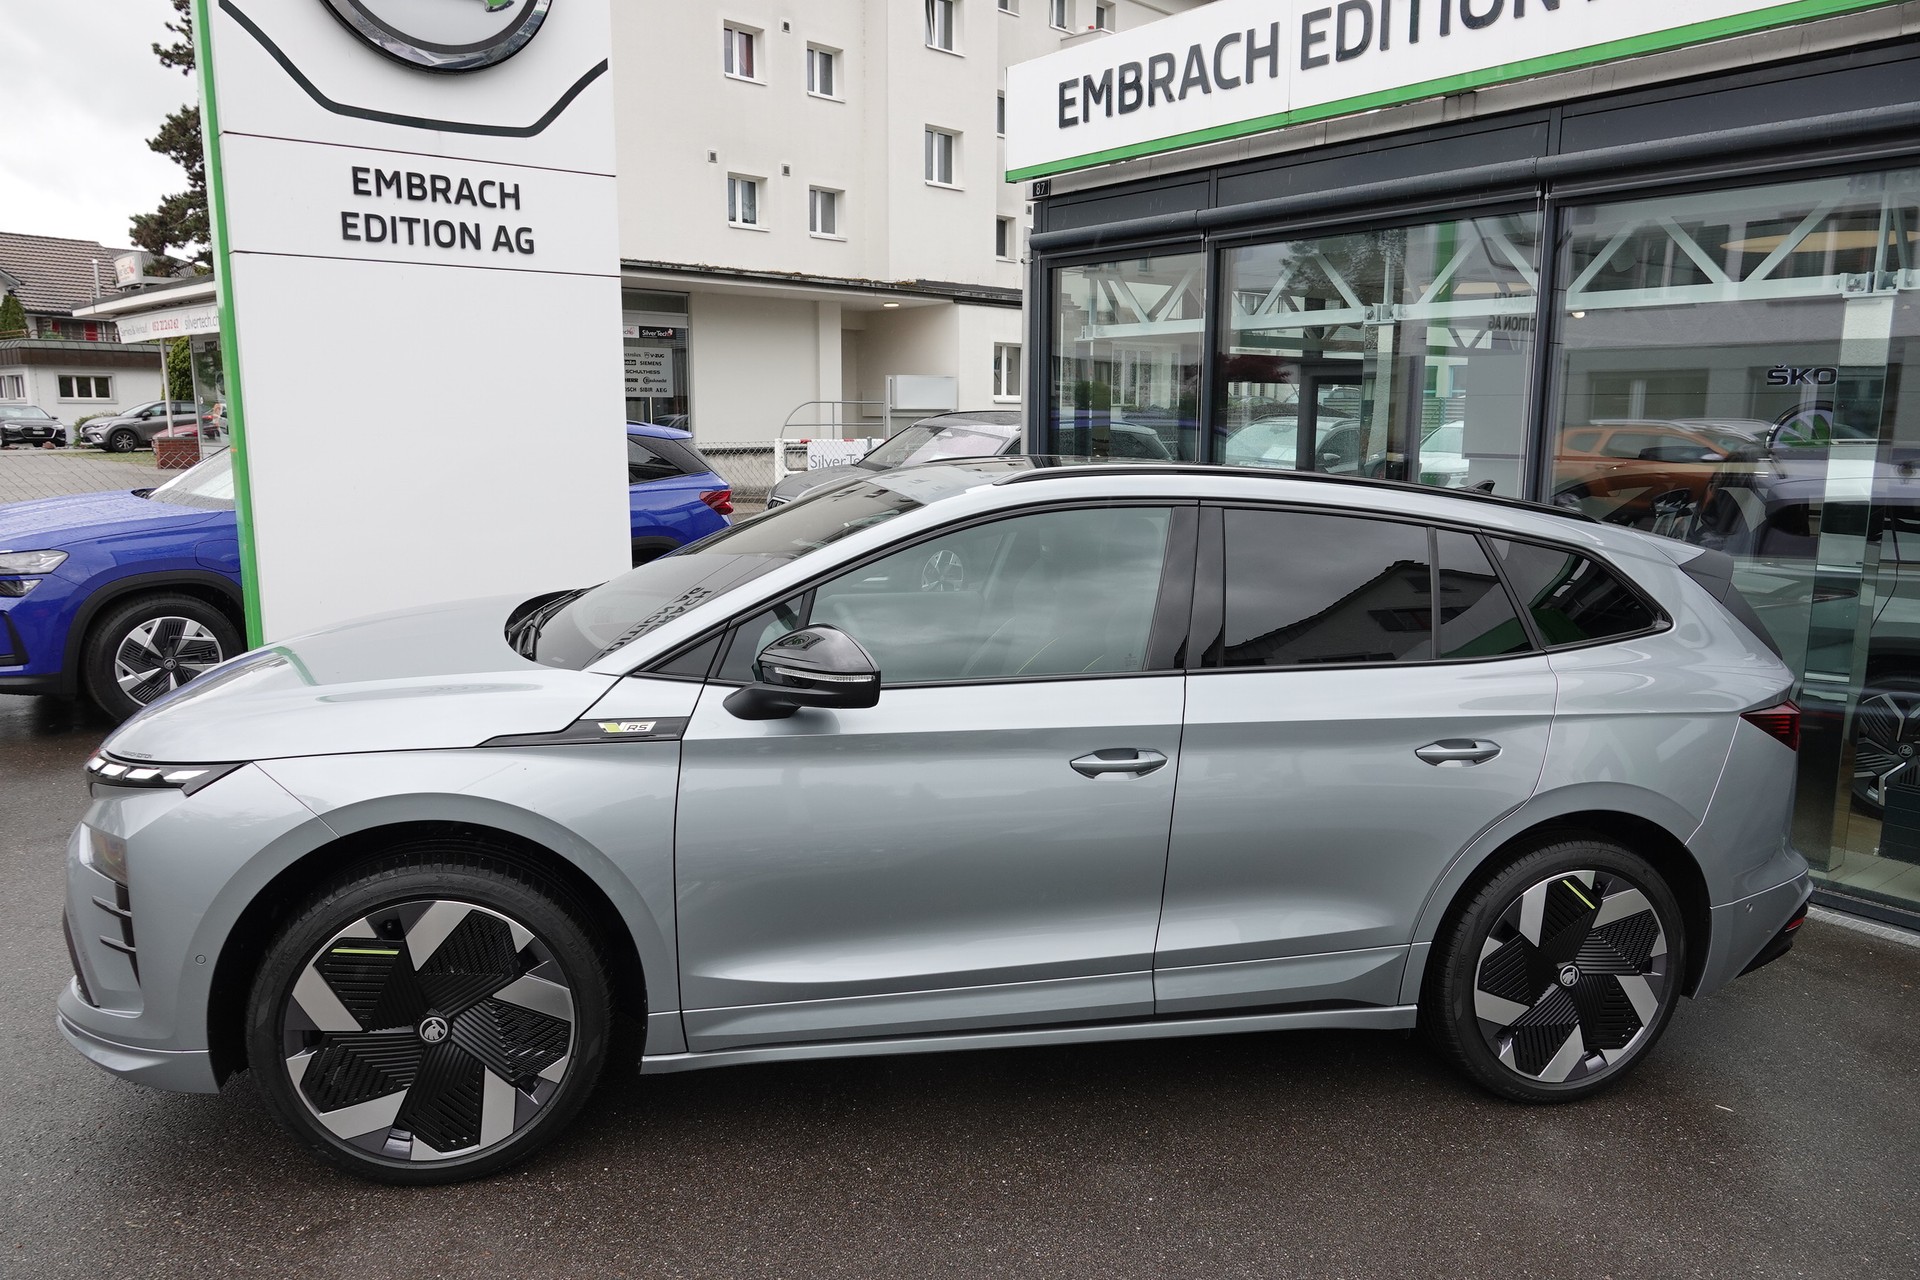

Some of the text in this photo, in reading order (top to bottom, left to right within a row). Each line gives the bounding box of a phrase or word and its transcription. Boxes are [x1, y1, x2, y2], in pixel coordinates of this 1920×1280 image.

[1058, 0, 1560, 129] EMBRACH EDITIO
[351, 165, 521, 211] EMBRACH
[1035, 182, 1046, 195] 87
[341, 212, 535, 254] EDITION AG
